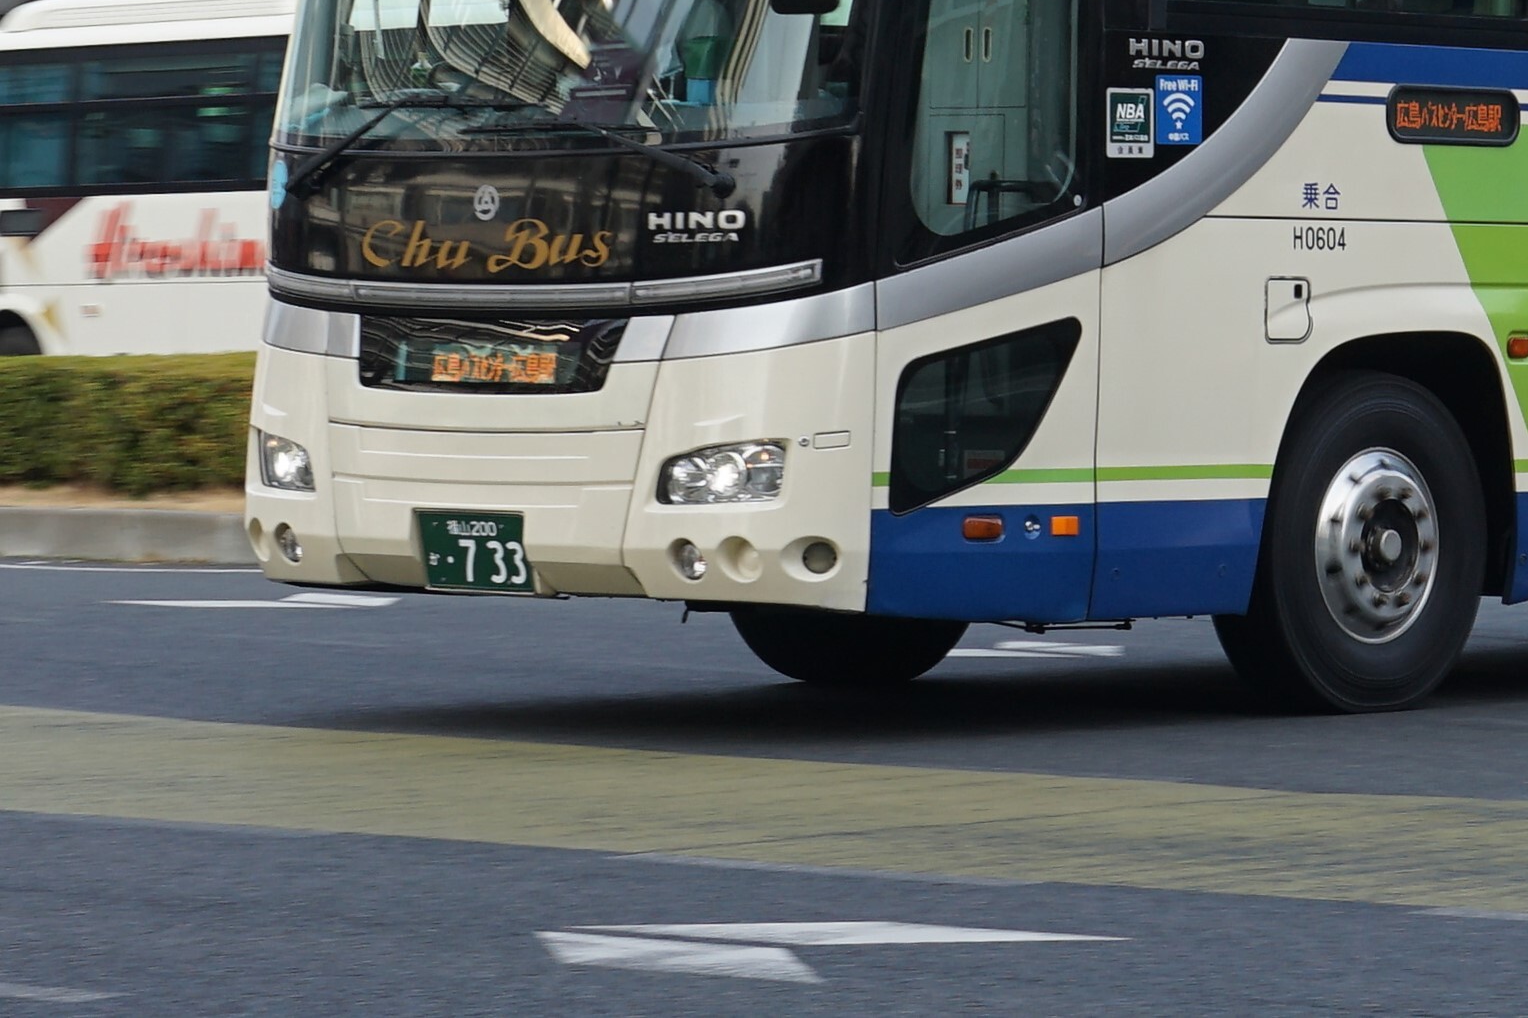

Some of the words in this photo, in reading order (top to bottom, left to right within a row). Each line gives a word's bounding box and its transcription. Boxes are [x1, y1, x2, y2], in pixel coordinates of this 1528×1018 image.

[1128, 38, 1205, 59] HINO
[1132, 58, 1200, 70] SELEGA
[1160, 78, 1177, 91] Free
[1178, 79, 1198, 91] Wi-Fi
[1116, 103, 1145, 119] NBA
[1302, 182, 1341, 210] 乗合
[648, 210, 746, 230] HINO
[362, 220, 473, 270] Chu
[488, 218, 613, 273] Bus
[652, 232, 740, 243] SELEGA
[1293, 225, 1347, 251] H0604
